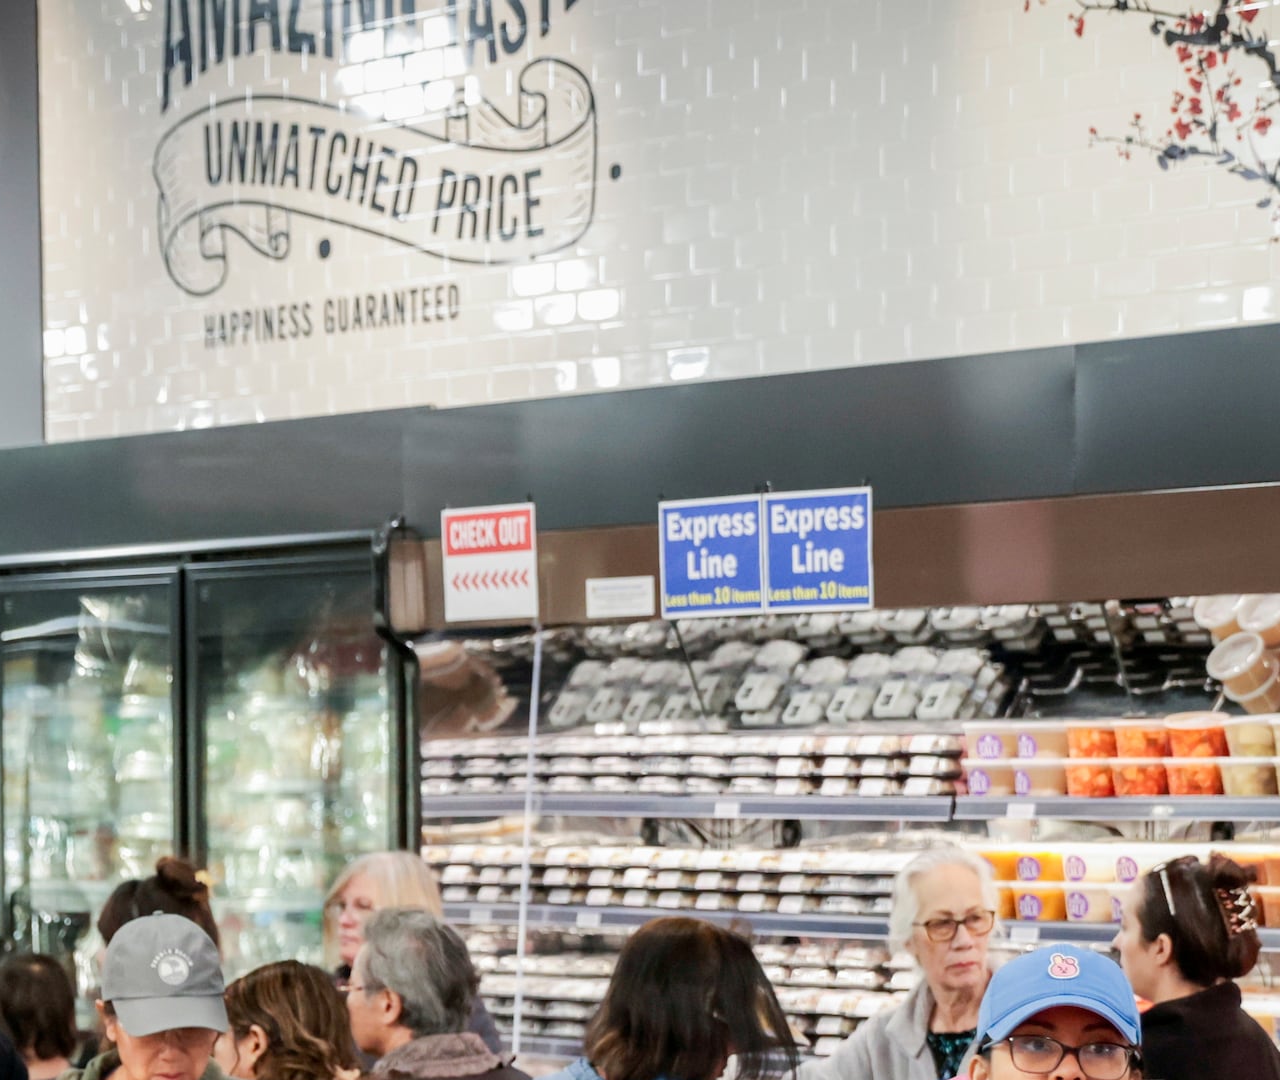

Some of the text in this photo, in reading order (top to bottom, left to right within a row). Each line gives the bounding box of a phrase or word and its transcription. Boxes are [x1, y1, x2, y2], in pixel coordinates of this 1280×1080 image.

[204, 120, 544, 242] UNMATCHED PRICE
[204, 283, 460, 348] HAPPINESS GUARANTEED
[450, 515, 528, 550] CHECK OUT
[666, 512, 757, 547] Express
[771, 503, 866, 540] Express
[687, 547, 738, 580] Line
[792, 540, 845, 574] Line
[664, 592, 688, 608] Less
[688, 590, 713, 606] than
[714, 586, 731, 605] 10
[732, 588, 761, 604] items
[768, 580, 869, 602] Less than 10 items
